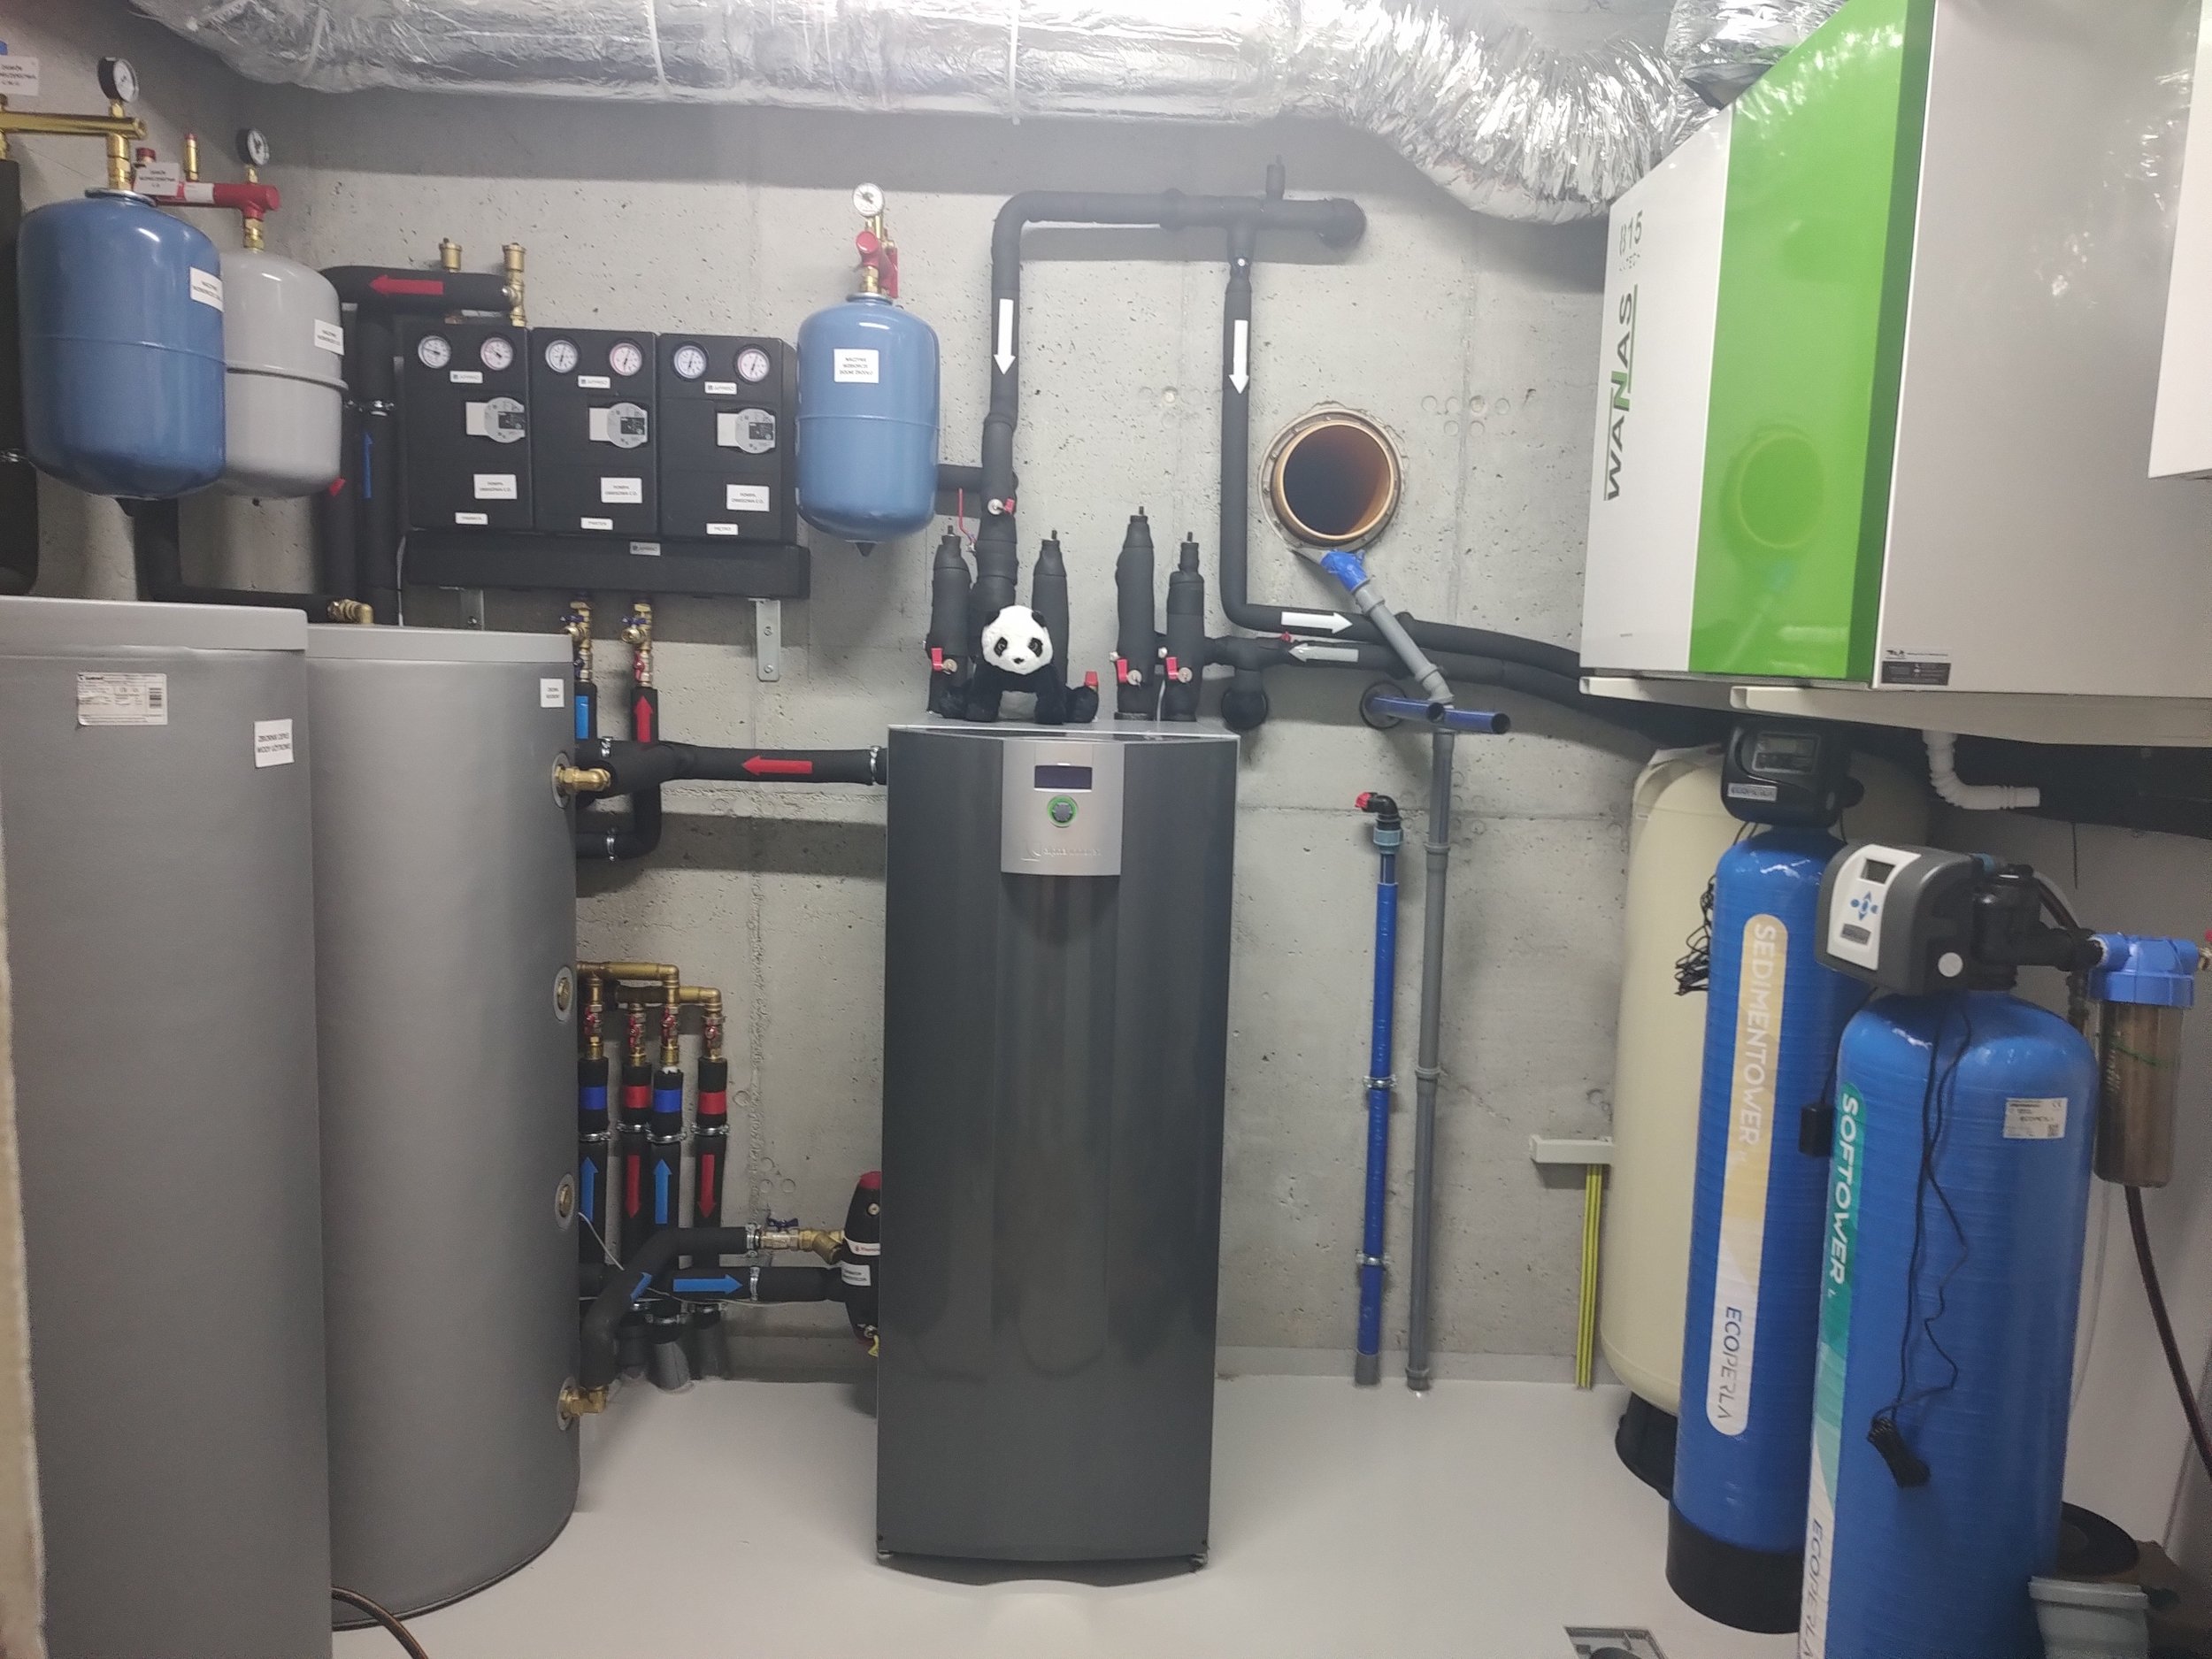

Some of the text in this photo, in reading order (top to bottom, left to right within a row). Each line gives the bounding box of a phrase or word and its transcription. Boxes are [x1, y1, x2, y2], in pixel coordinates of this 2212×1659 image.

[1607, 293, 1632, 501] WANAS
[1739, 923, 1777, 1146] SEDIMENTOWER
[1828, 1094, 1859, 1285] SOFTOWER
[1717, 1306, 1743, 1419] ECOPERLA
